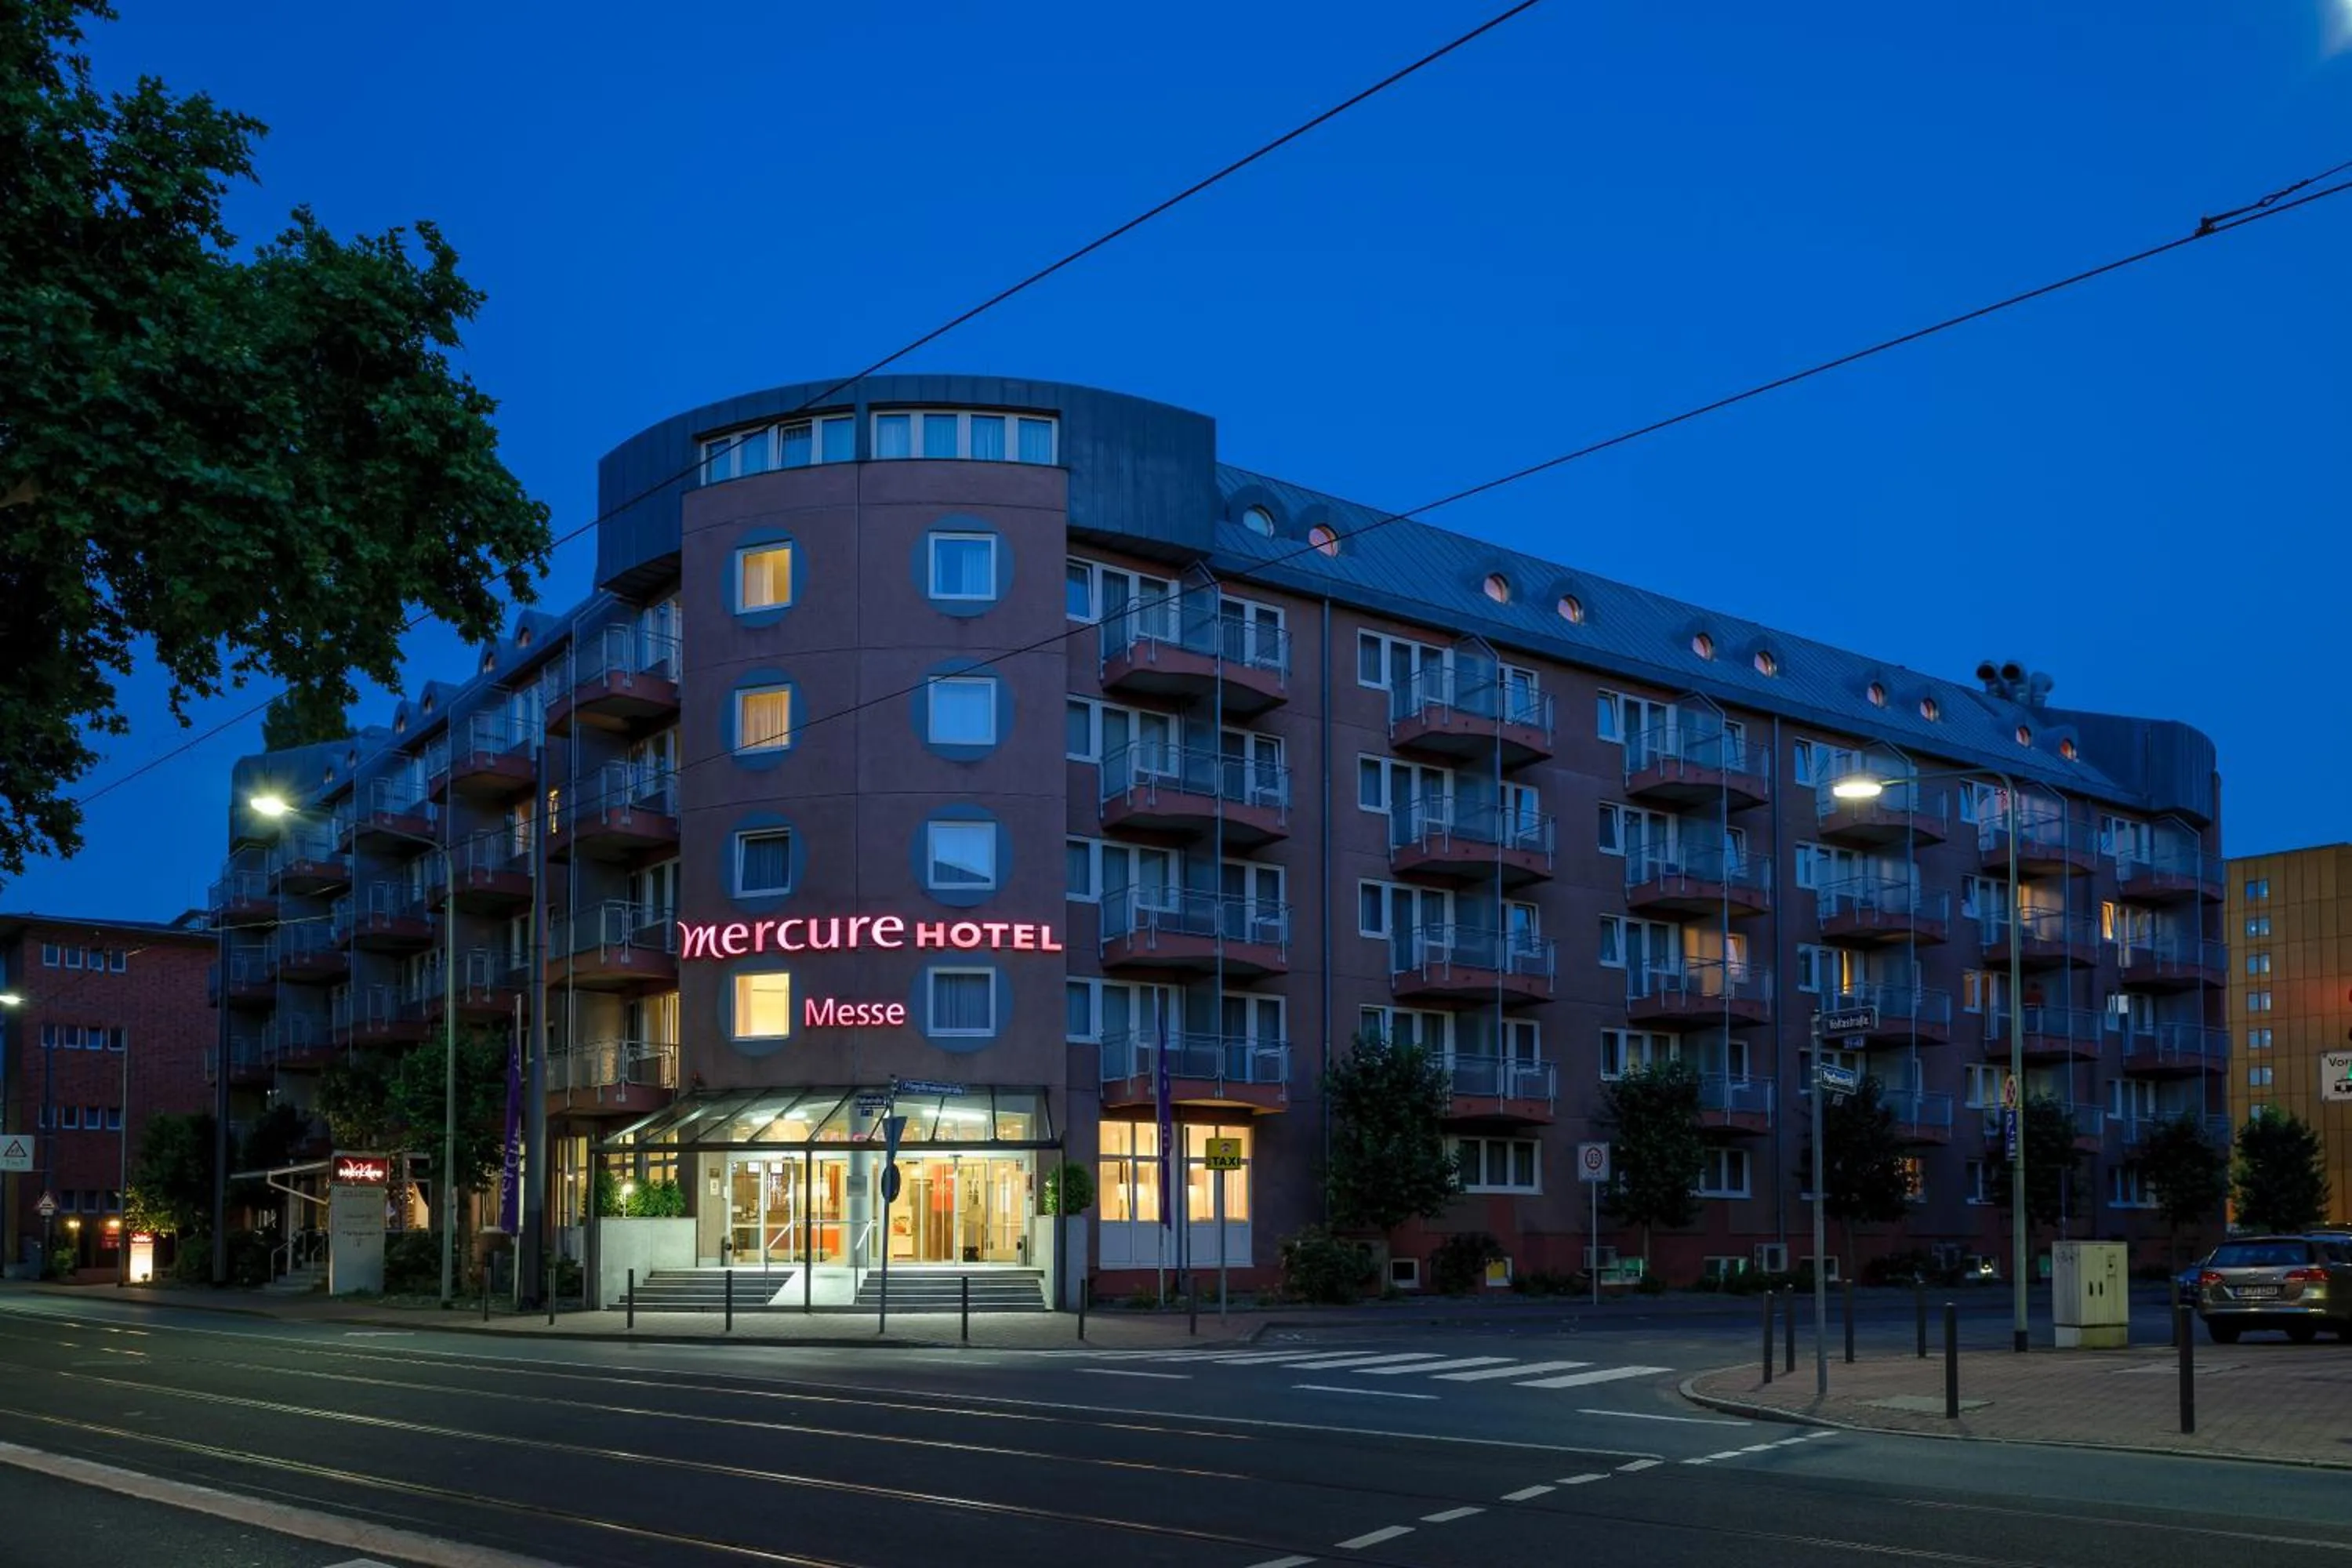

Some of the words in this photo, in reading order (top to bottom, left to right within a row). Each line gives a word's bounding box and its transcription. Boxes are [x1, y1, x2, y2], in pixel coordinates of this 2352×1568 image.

[916, 921, 1063, 951] HOTEL
[804, 997, 906, 1025] Messe
[1213, 1156, 1240, 1166] TAXI
